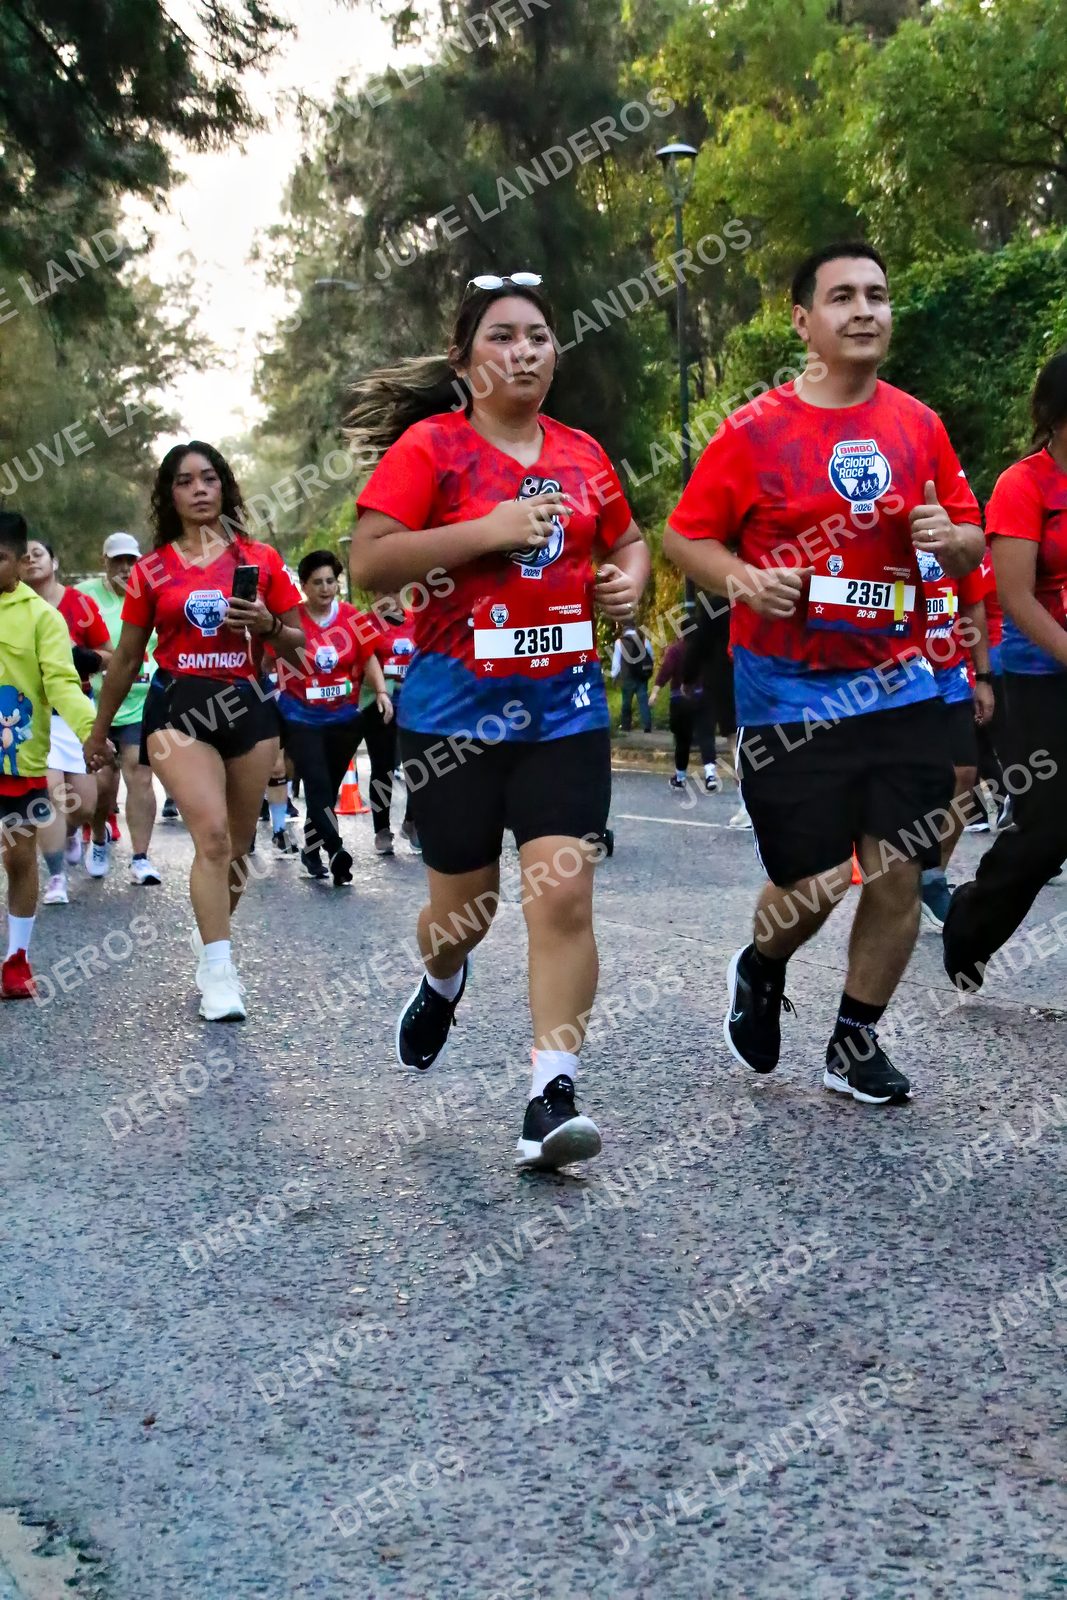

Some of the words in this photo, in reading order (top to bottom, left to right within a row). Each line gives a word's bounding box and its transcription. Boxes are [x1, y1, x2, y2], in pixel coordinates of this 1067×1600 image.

[840, 445, 873, 454] BIMBO
[843, 456, 875, 468] Global
[839, 467, 864, 478] Race
[853, 503, 872, 512] 2026
[523, 568, 541, 577] 2026
[846, 581, 891, 607] 2351
[895, 623, 905, 632] 5K
[514, 626, 563, 655] 2350
[178, 652, 247, 669] SANTIAGO
[572, 665, 584, 674] 5K
[321, 686, 340, 697] 3020
